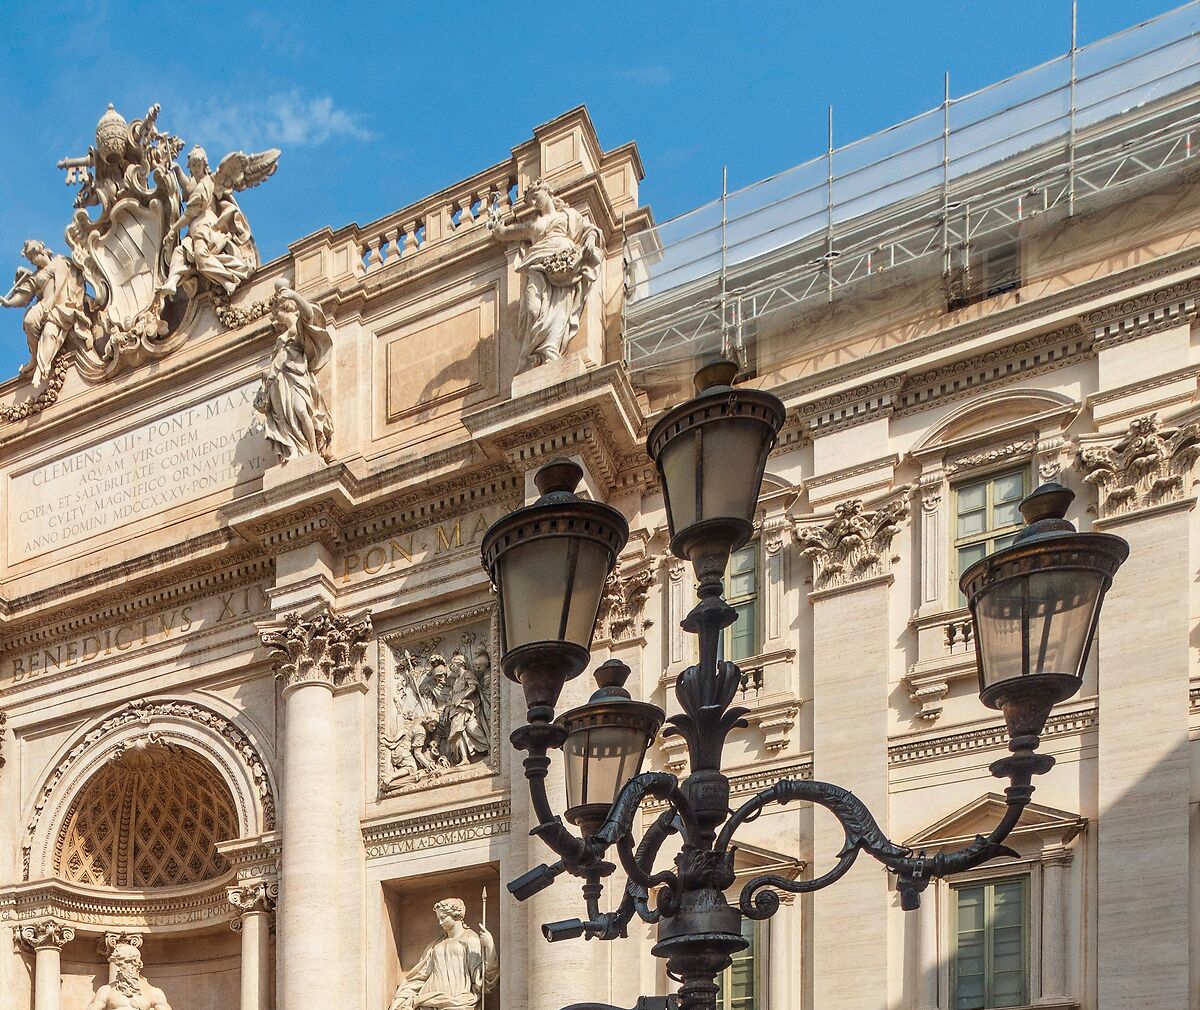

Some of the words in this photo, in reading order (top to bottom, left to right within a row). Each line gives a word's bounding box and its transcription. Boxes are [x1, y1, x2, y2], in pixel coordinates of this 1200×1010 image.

[32, 447, 102, 487] CLEMENS
[80, 460, 124, 485] AQVAM
[132, 430, 198, 463] VIRGINEM
[20, 503, 53, 523] COPIA
[58, 495, 71, 509] ET
[75, 463, 154, 502] SALVBRITATE
[48, 504, 87, 528] CVLTV
[95, 476, 166, 511] MAGNIFICO
[173, 449, 235, 481] ORNAVIT
[24, 532, 59, 552] ANNO
[62, 513, 107, 539] DOMINI
[12, 606, 192, 683] BENEDICTVS
[366, 839, 414, 858] SOLVTVM
